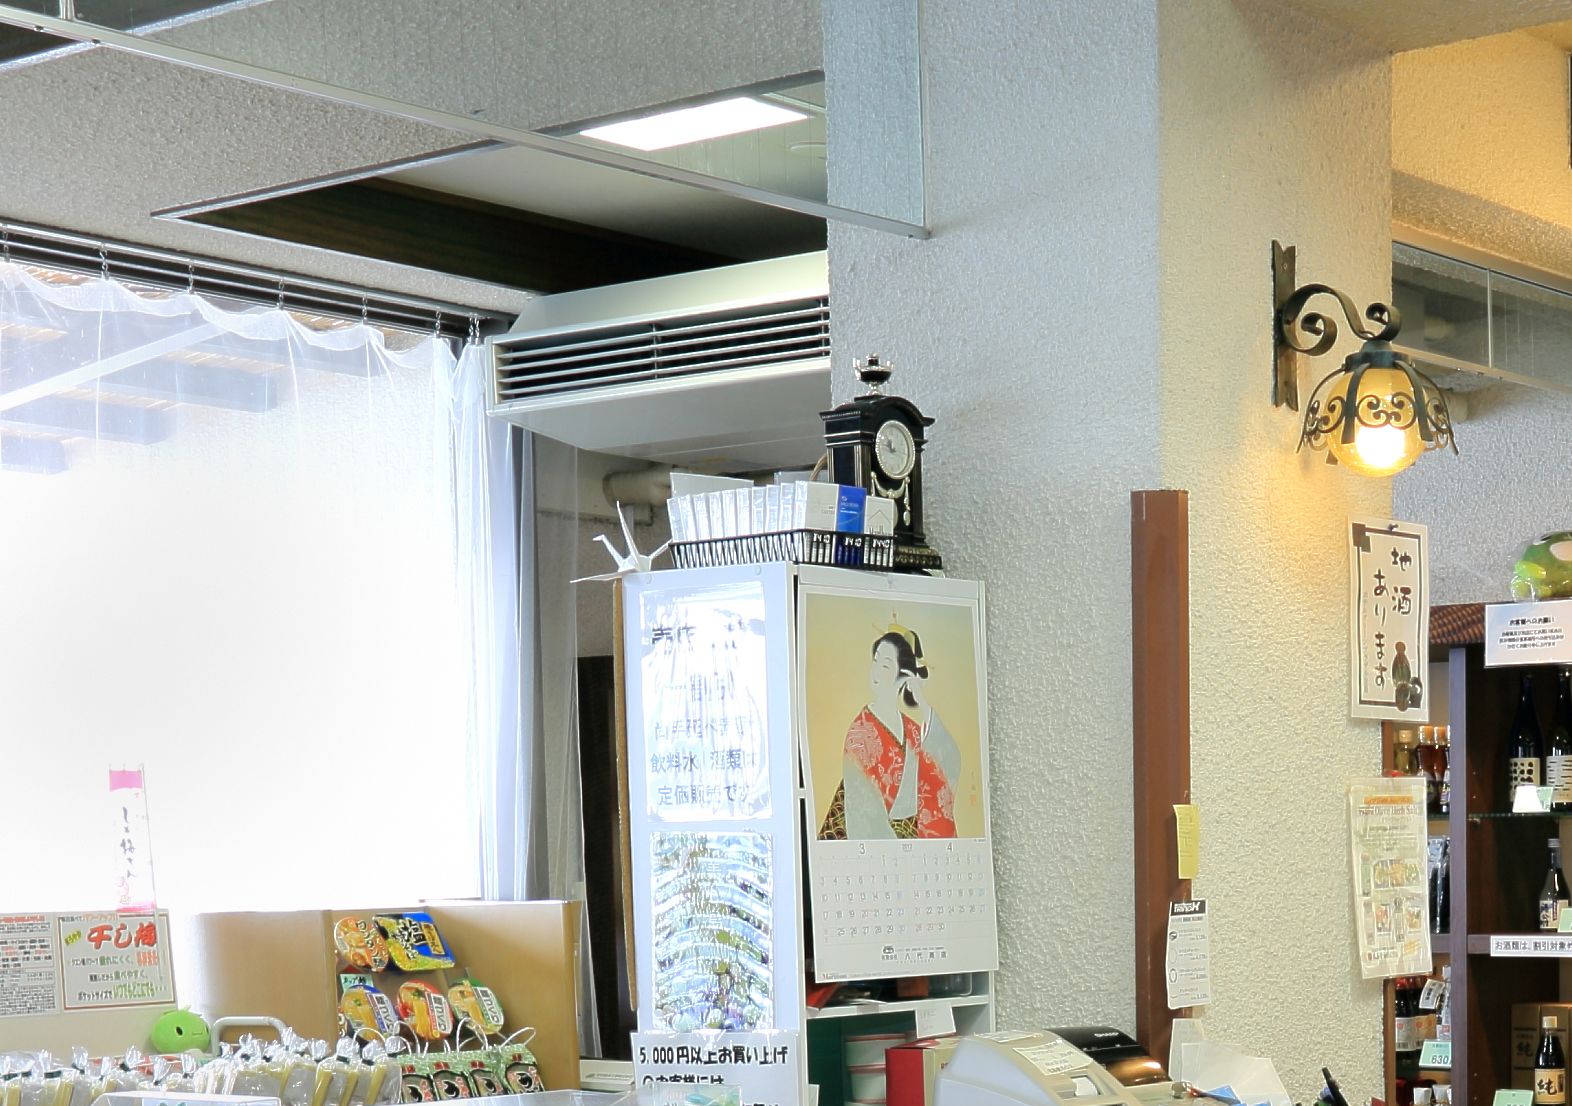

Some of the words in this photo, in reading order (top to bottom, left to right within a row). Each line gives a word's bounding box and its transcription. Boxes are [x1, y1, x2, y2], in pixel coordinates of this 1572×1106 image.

[1391, 547, 1412, 615] 地酒
[1373, 568, 1389, 690] あります
[87, 921, 158, 950] 干し梅
